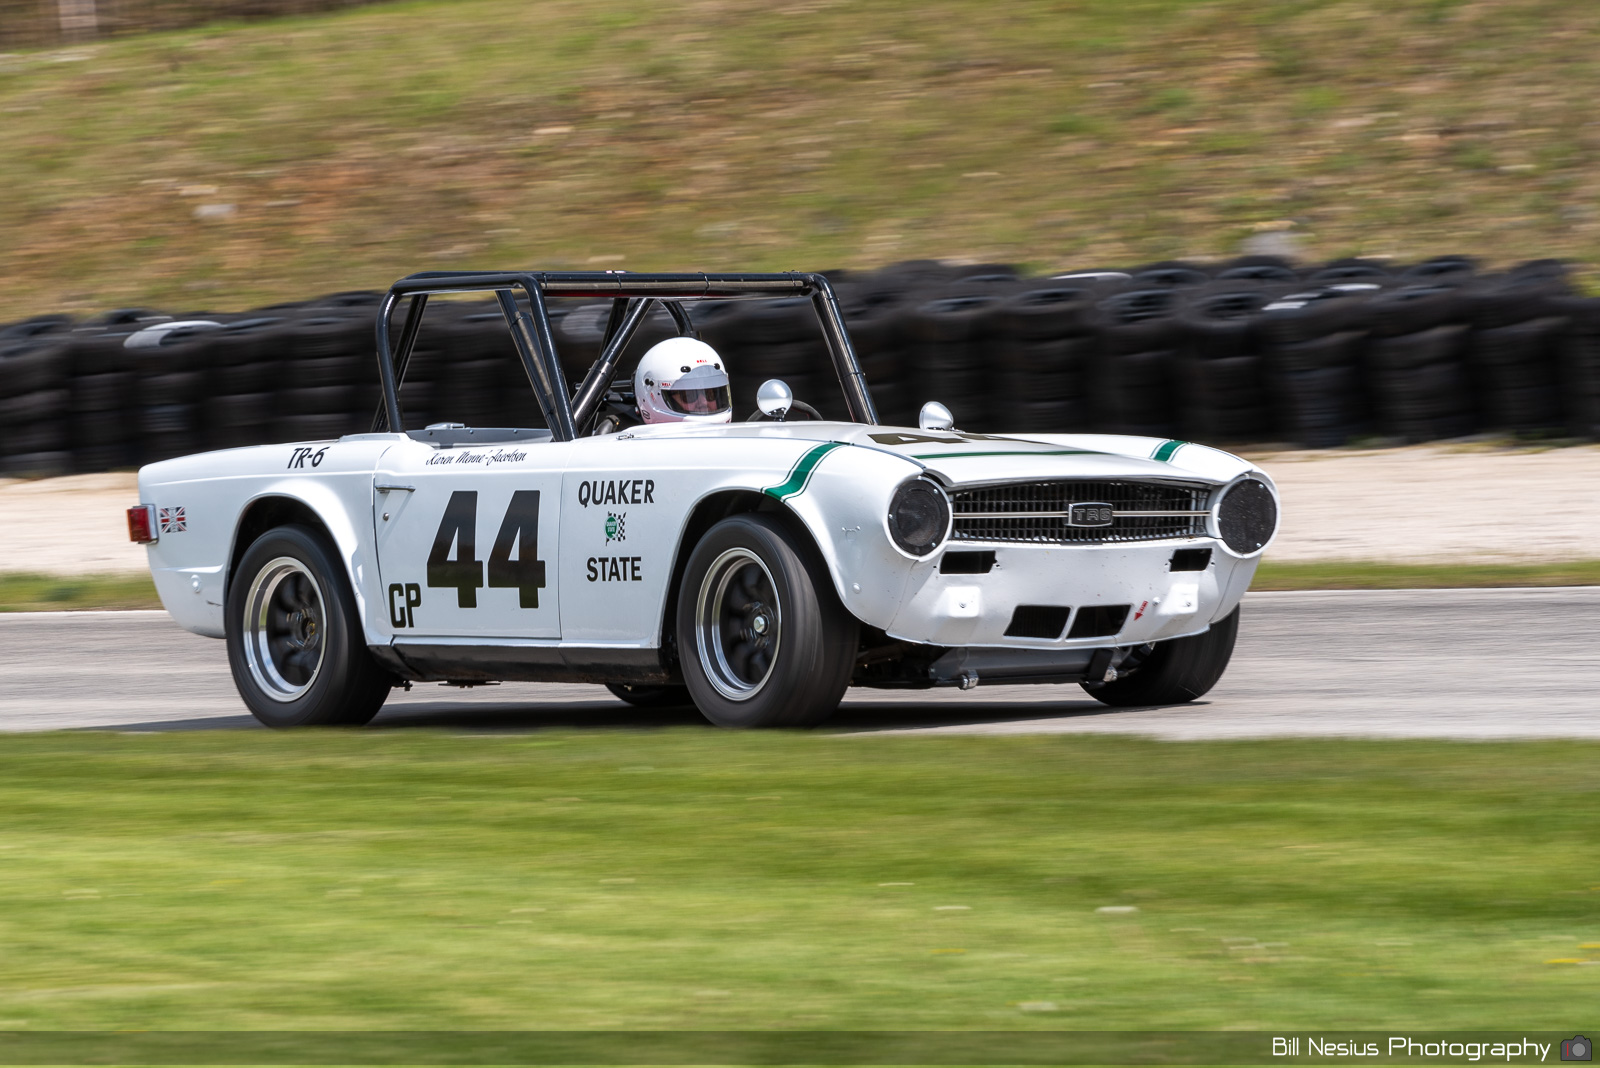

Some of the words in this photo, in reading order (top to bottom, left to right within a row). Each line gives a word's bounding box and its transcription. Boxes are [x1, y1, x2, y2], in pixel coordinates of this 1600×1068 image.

[287, 446, 331, 469] TR-6
[426, 452, 454, 465] Karen
[578, 480, 655, 508] QUAKER
[1073, 508, 1111, 520] TR6
[426, 490, 546, 608] 44
[586, 556, 642, 582] STATE
[388, 582, 422, 628] CP
